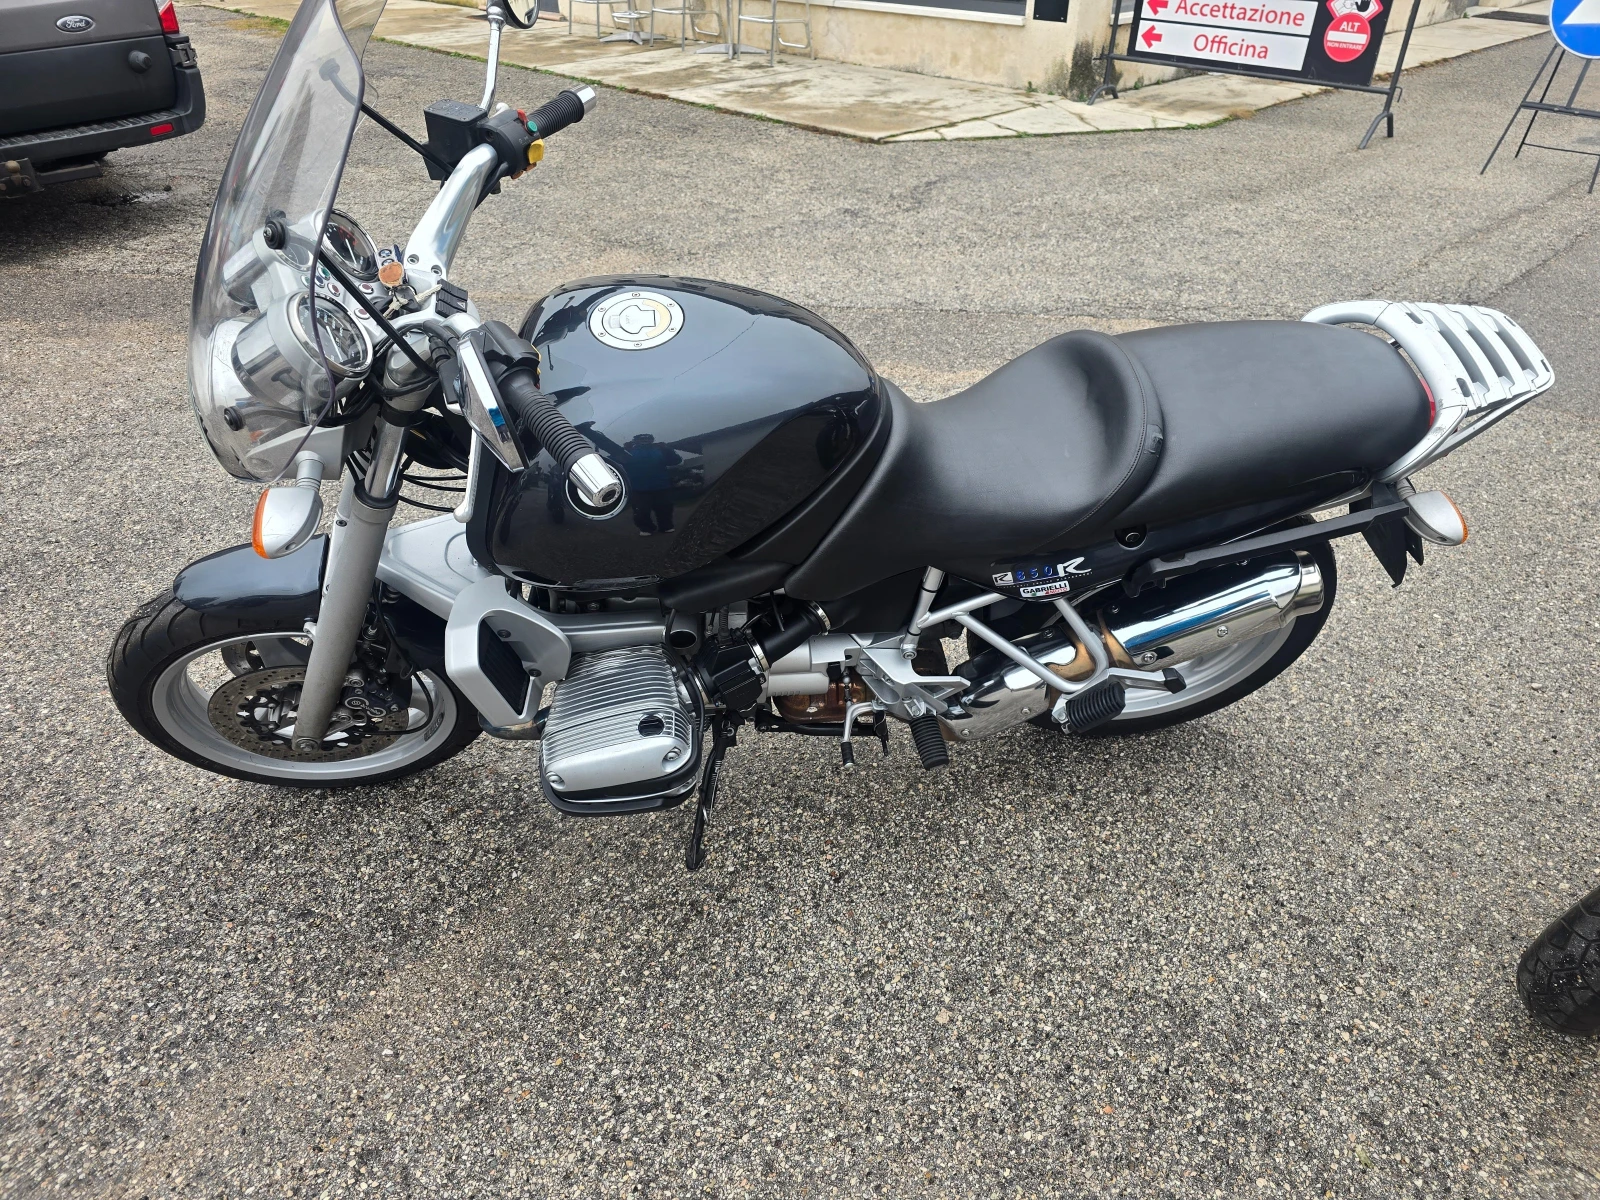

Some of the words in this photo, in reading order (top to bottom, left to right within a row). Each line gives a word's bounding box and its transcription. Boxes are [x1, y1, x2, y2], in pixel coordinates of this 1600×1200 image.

[1175, 0, 1305, 27] Accettazione
[66, 19, 86, 28] Ford
[1339, 21, 1361, 32] ALT
[1193, 33, 1269, 60] Officina
[1340, 42, 1363, 50] ENTRARE
[1022, 582, 1068, 594] GABRIELLI
